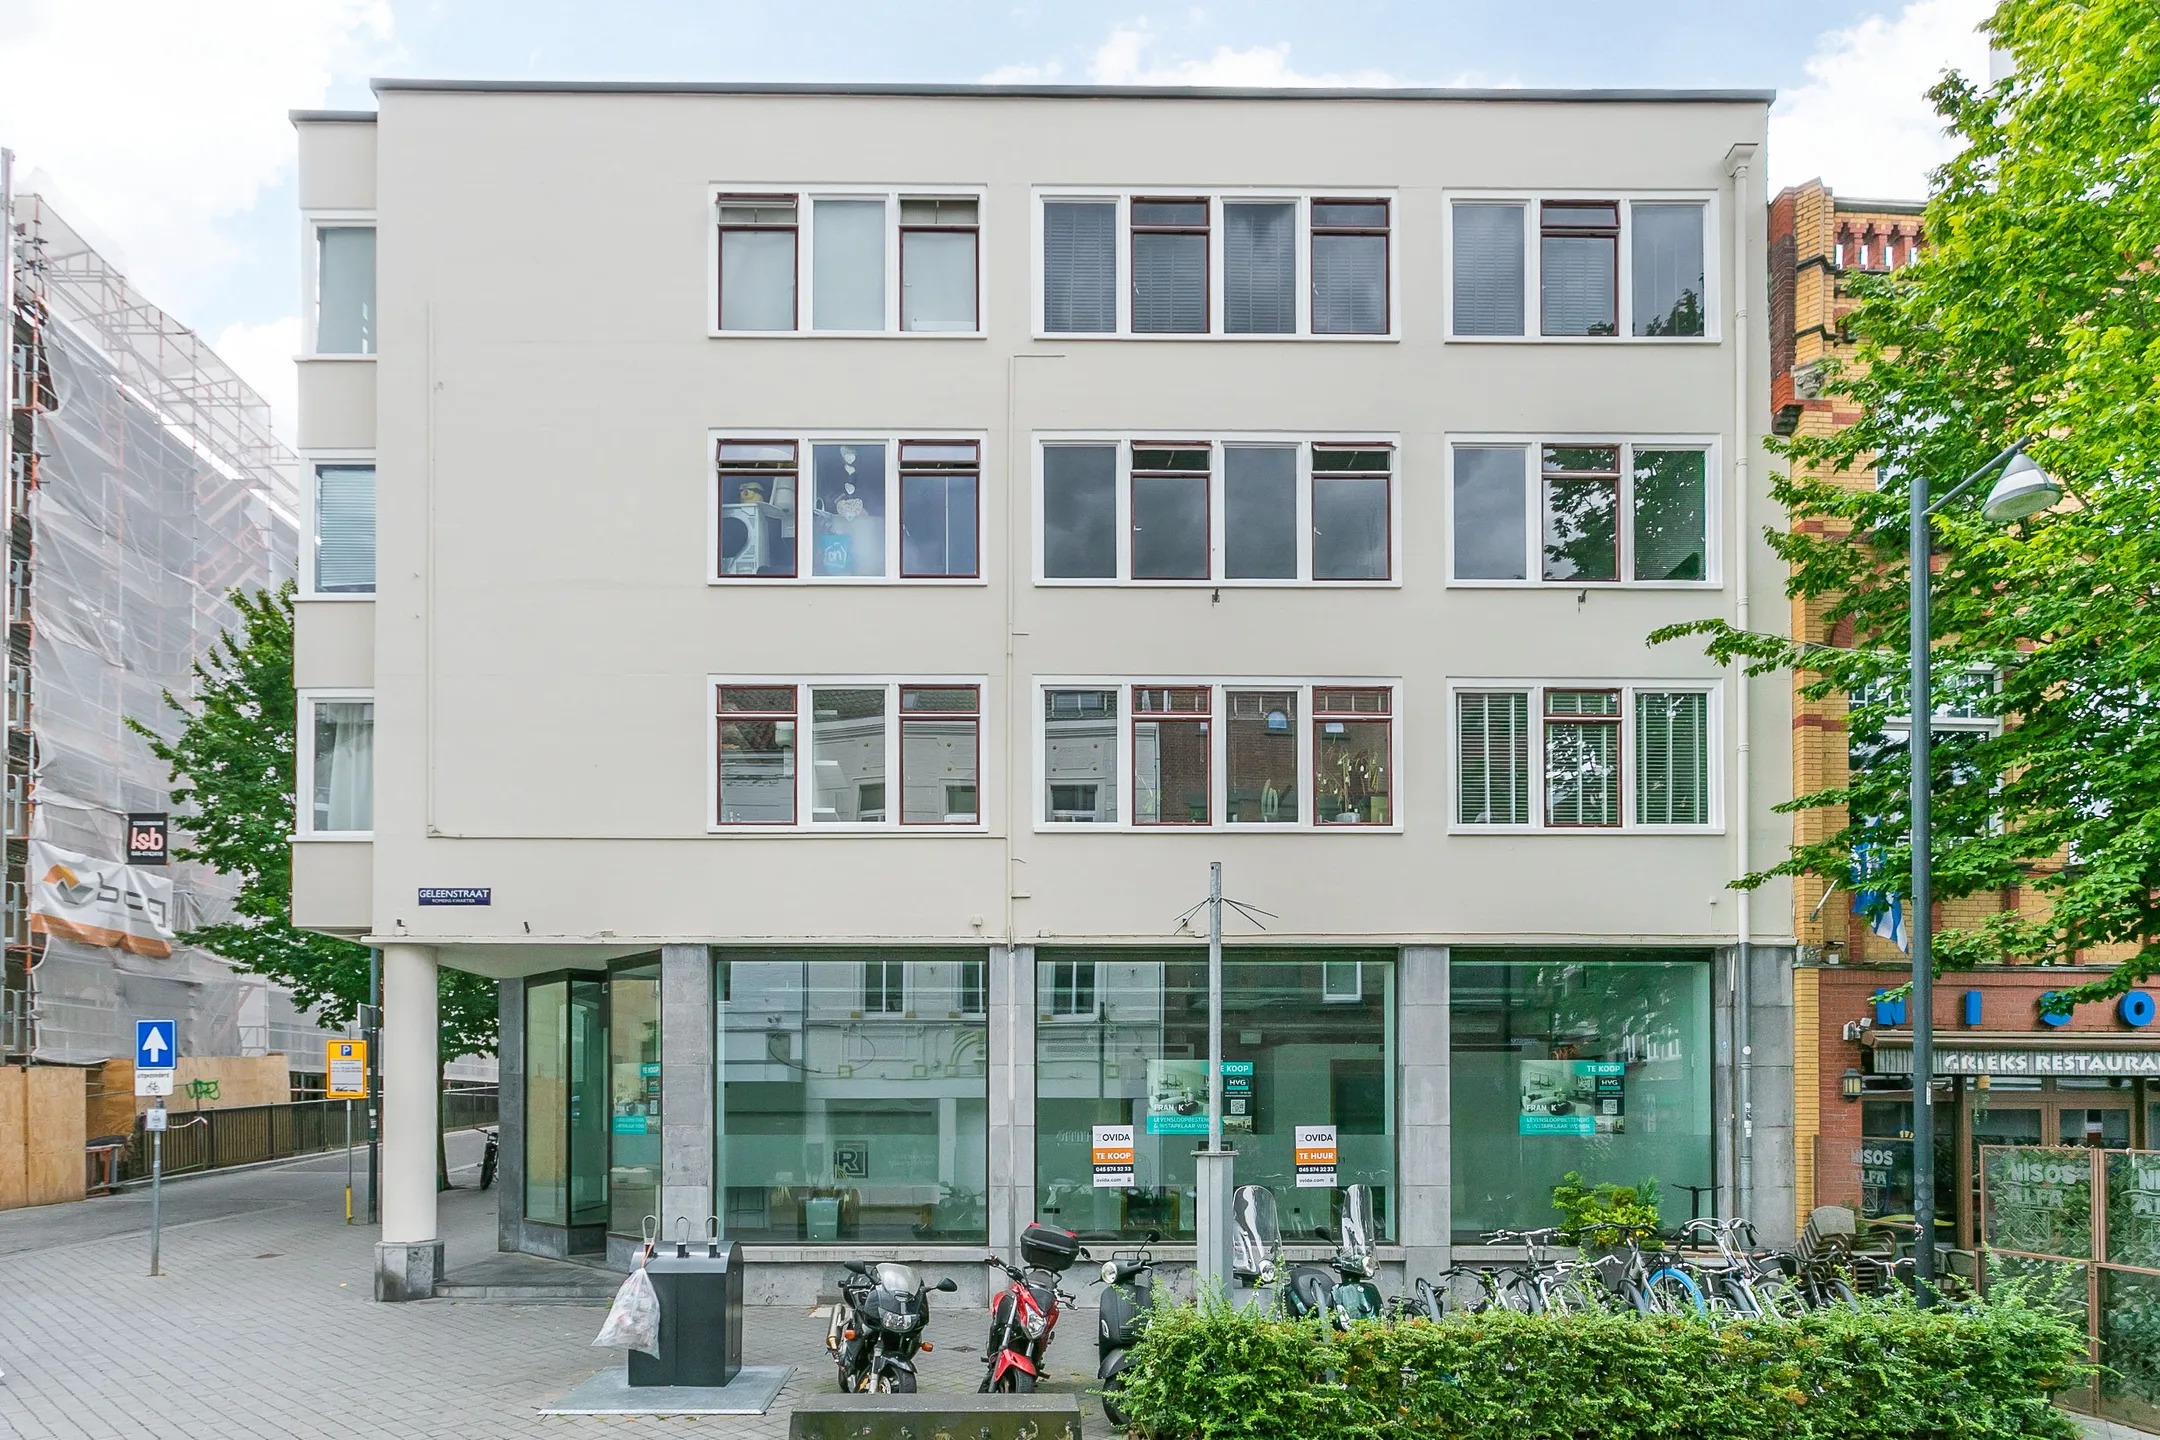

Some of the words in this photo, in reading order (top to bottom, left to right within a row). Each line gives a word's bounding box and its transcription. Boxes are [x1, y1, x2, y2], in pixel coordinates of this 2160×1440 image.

[420, 890, 489, 898] GELEENSTRAAT
[1944, 1054, 2027, 1071] GRIEKS
[2035, 1055, 2160, 1072] RESTAURA
[1227, 1065, 1249, 1073] KOOP
[1587, 1065, 1596, 1073] TE
[1599, 1065, 1620, 1073] KOOP
[1102, 1133, 1130, 1141] OVIDA
[1305, 1133, 1333, 1141] OVIDA
[1096, 1152, 1106, 1160] TE
[1107, 1152, 1131, 1160] KOOP
[1299, 1152, 1309, 1160] TE
[1310, 1152, 1334, 1160] HUUR
